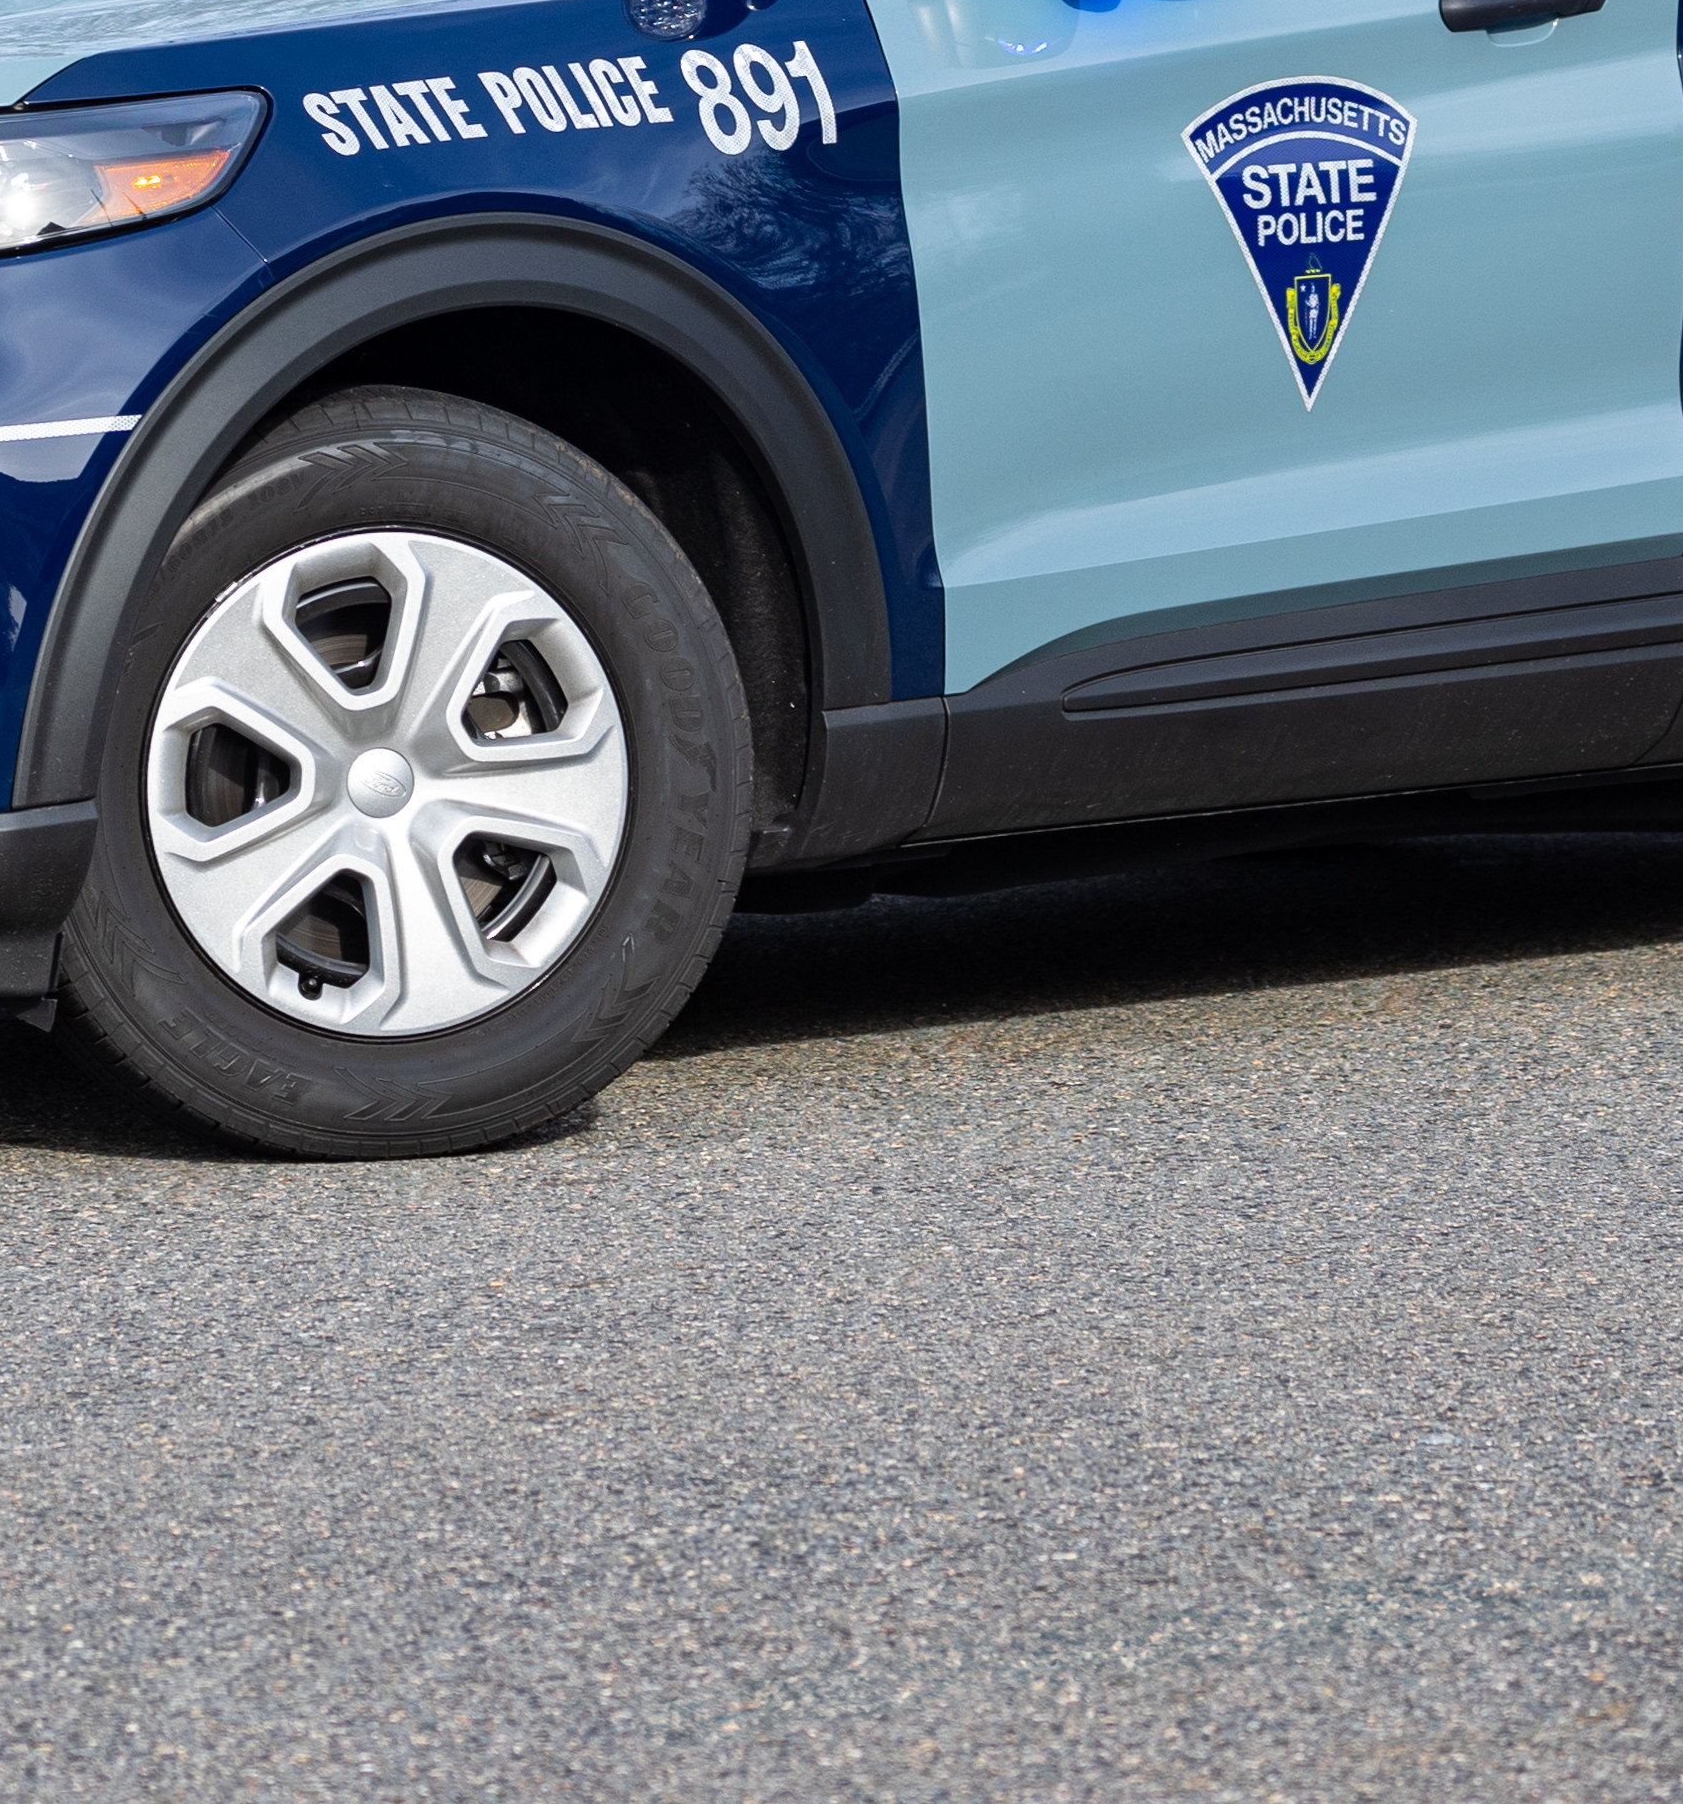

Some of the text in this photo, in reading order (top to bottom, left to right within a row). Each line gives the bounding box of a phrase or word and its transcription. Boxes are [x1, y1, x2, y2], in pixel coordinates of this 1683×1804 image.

[303, 40, 838, 156] STATE POLICE 891
[1194, 96, 1407, 164] MASSACHUSETTS
[1242, 158, 1377, 210] STATE
[1257, 209, 1365, 247] POLICE
[622, 582, 717, 943] GOODYEAR
[158, 1006, 313, 1107] EAGLE
